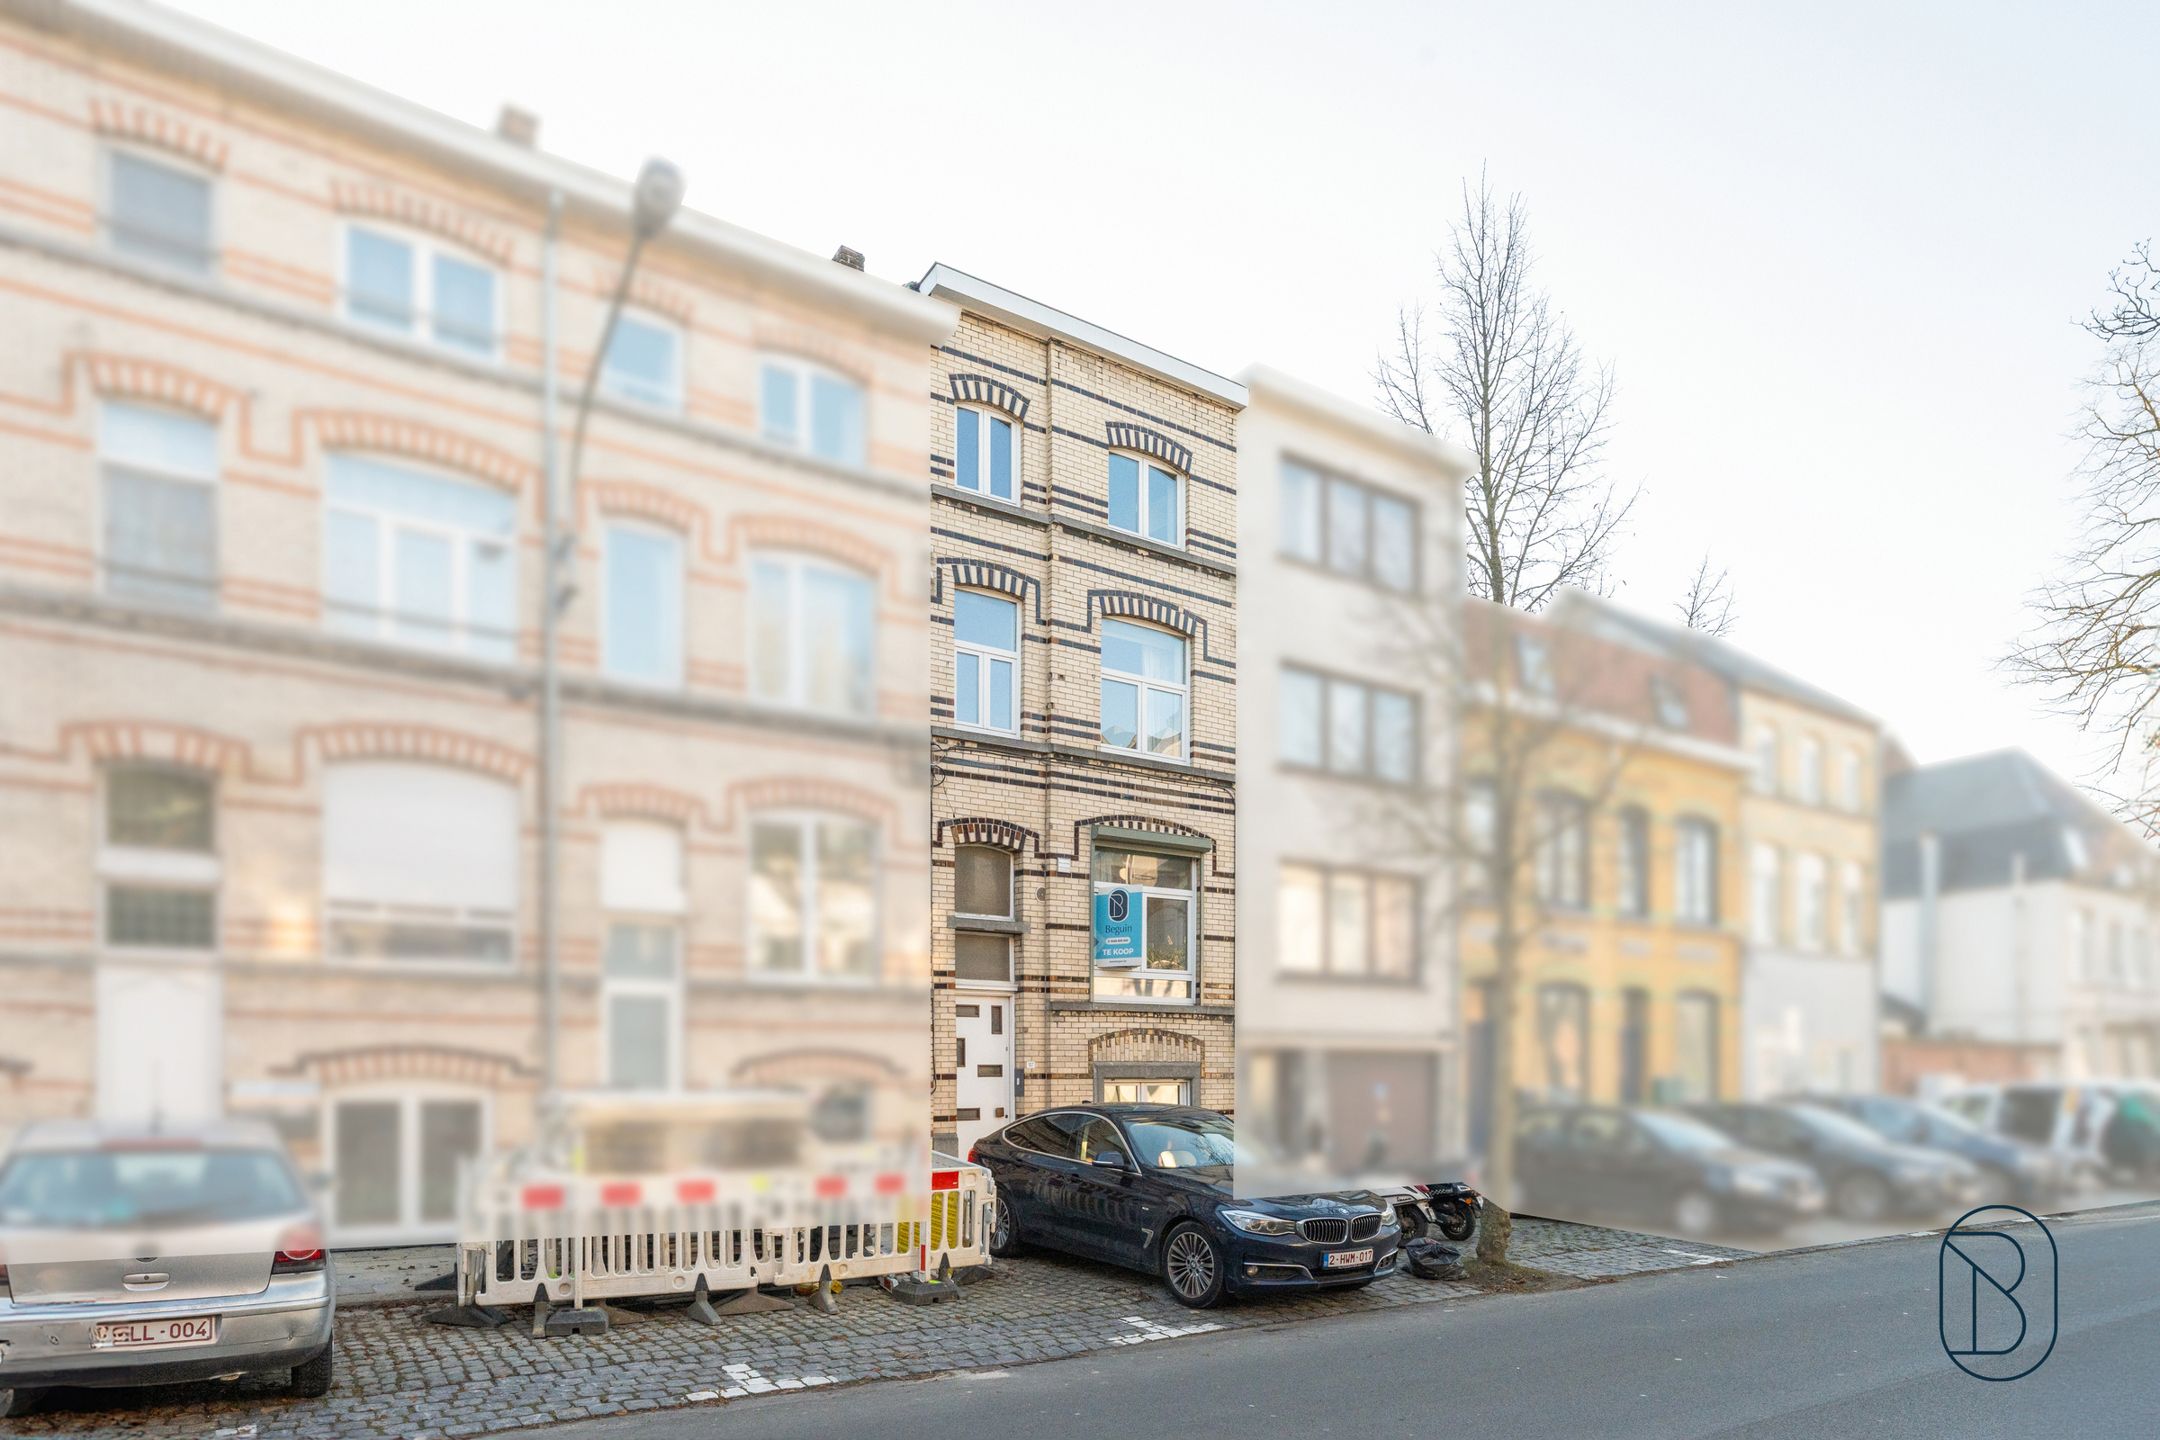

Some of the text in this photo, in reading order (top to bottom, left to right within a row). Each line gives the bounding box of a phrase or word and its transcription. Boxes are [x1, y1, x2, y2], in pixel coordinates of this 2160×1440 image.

[1105, 924, 1133, 936] Beguin
[1102, 947, 1134, 956] TE KOOP
